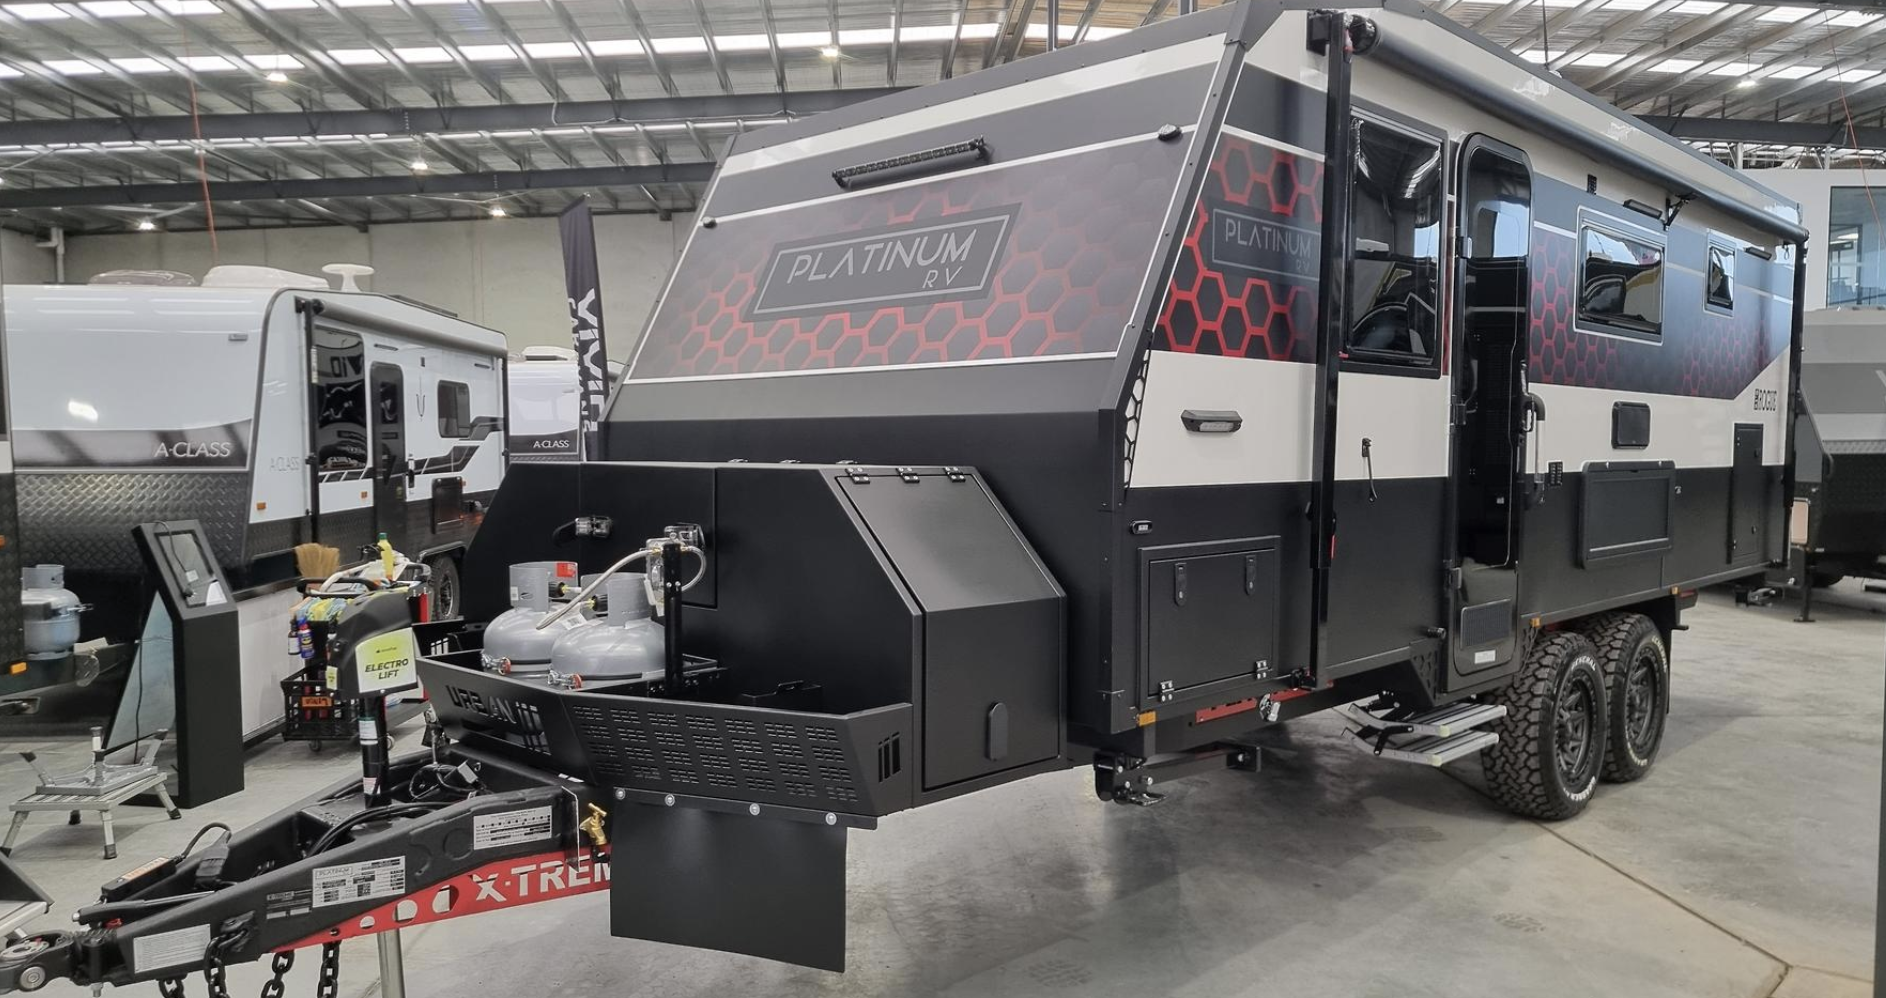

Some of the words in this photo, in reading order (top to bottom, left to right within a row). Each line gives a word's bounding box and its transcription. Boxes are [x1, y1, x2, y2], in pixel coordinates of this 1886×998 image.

[1225, 217, 1311, 259] PLATINUM
[787, 229, 977, 284] PLATINUM
[922, 266, 963, 289] RV
[365, 658, 409, 673] ELECTRO
[378, 669, 400, 680] LIFT
[445, 684, 518, 725] URBAN
